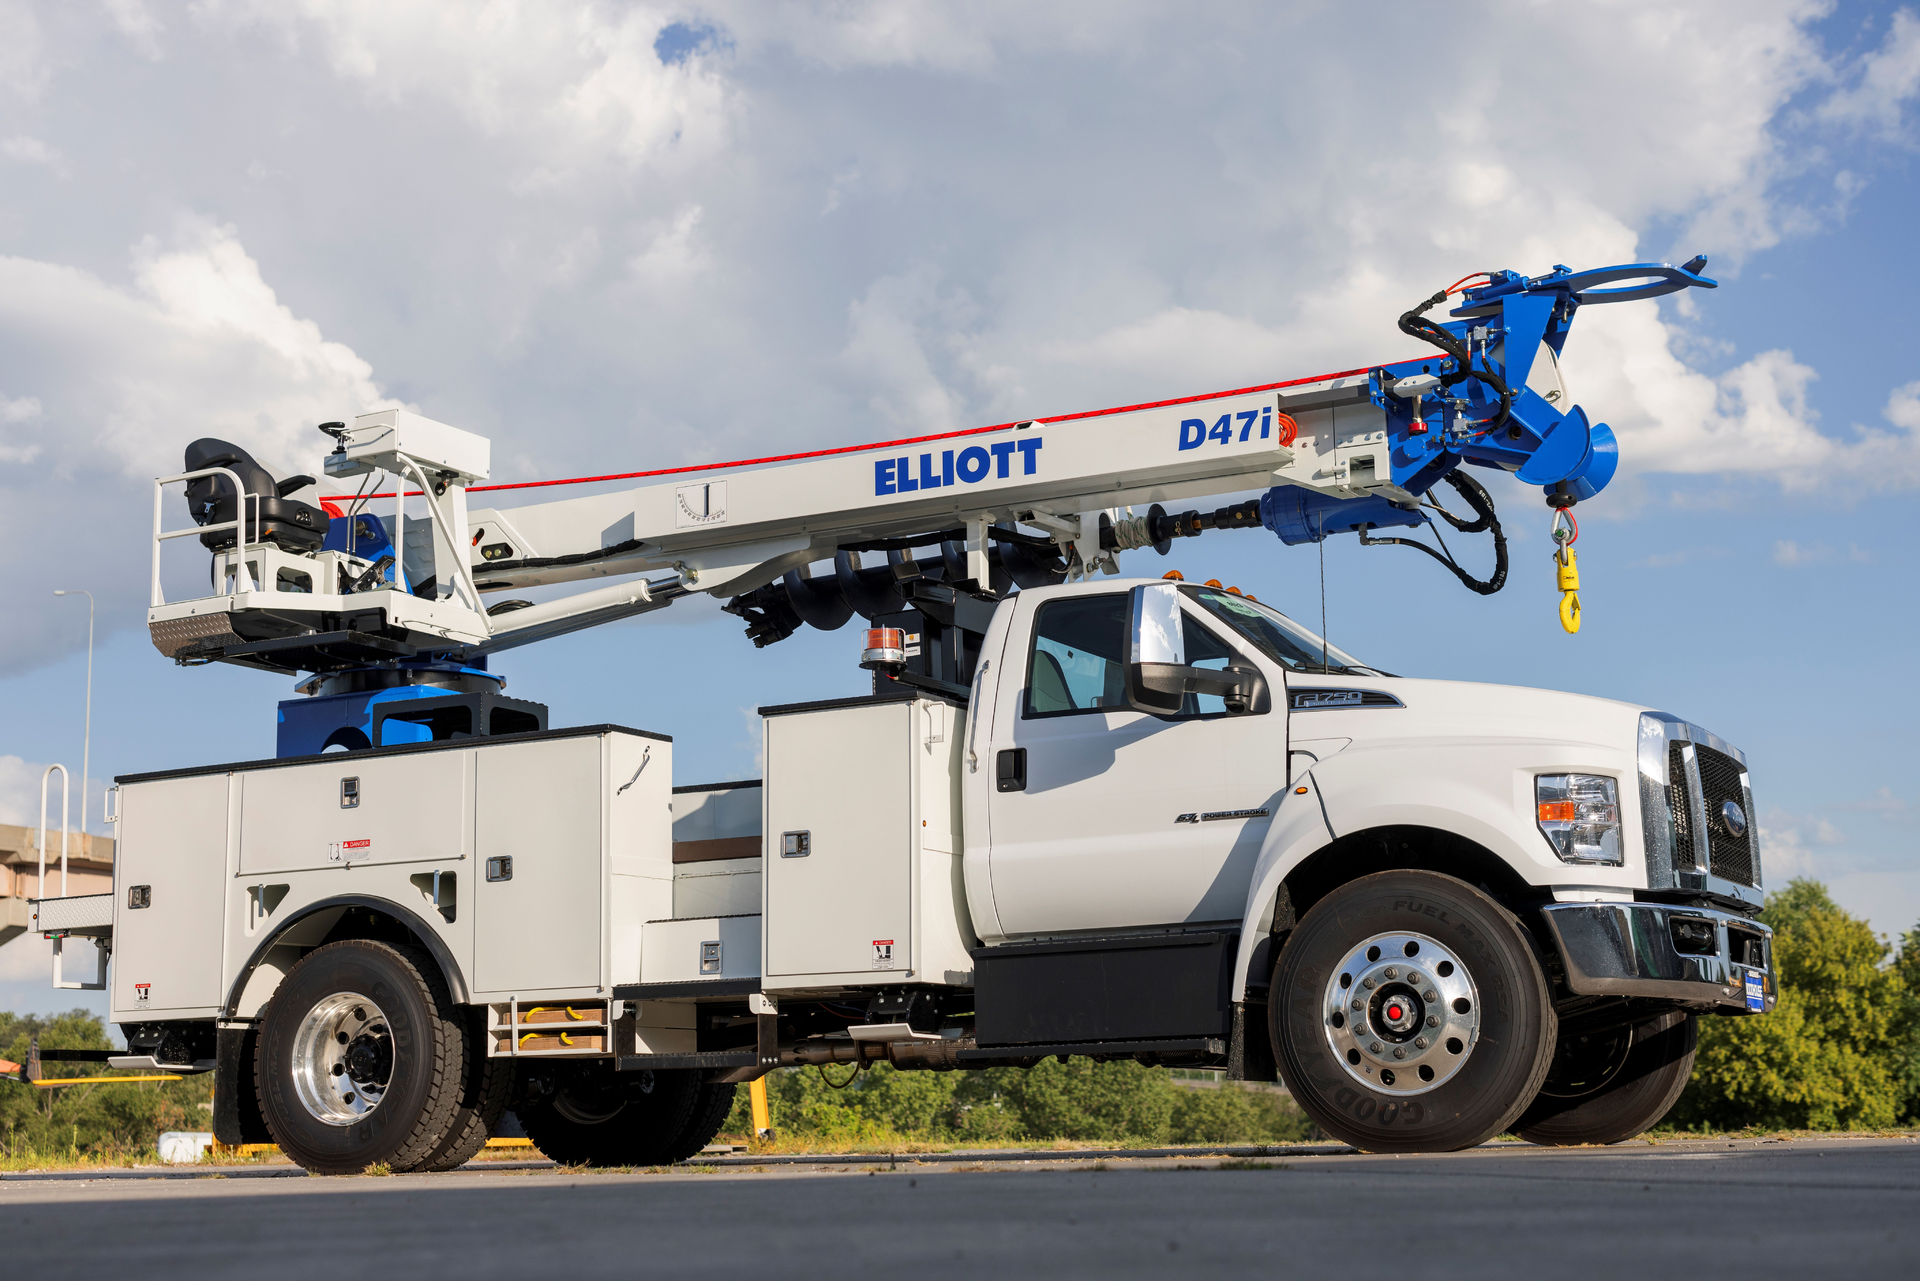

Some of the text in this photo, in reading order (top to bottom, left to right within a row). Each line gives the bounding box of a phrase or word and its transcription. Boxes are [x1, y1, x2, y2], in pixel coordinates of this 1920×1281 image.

[1178, 406, 1272, 451] D47i
[874, 437, 1042, 497] ELLIOTT
[1234, 809, 1267, 817] STROKE
[1392, 900, 1451, 925] FUEL
[1455, 923, 1496, 966] MAX
[358, 981, 414, 1143] GOODYEAR
[1291, 966, 1426, 1126] GOODYEAR
